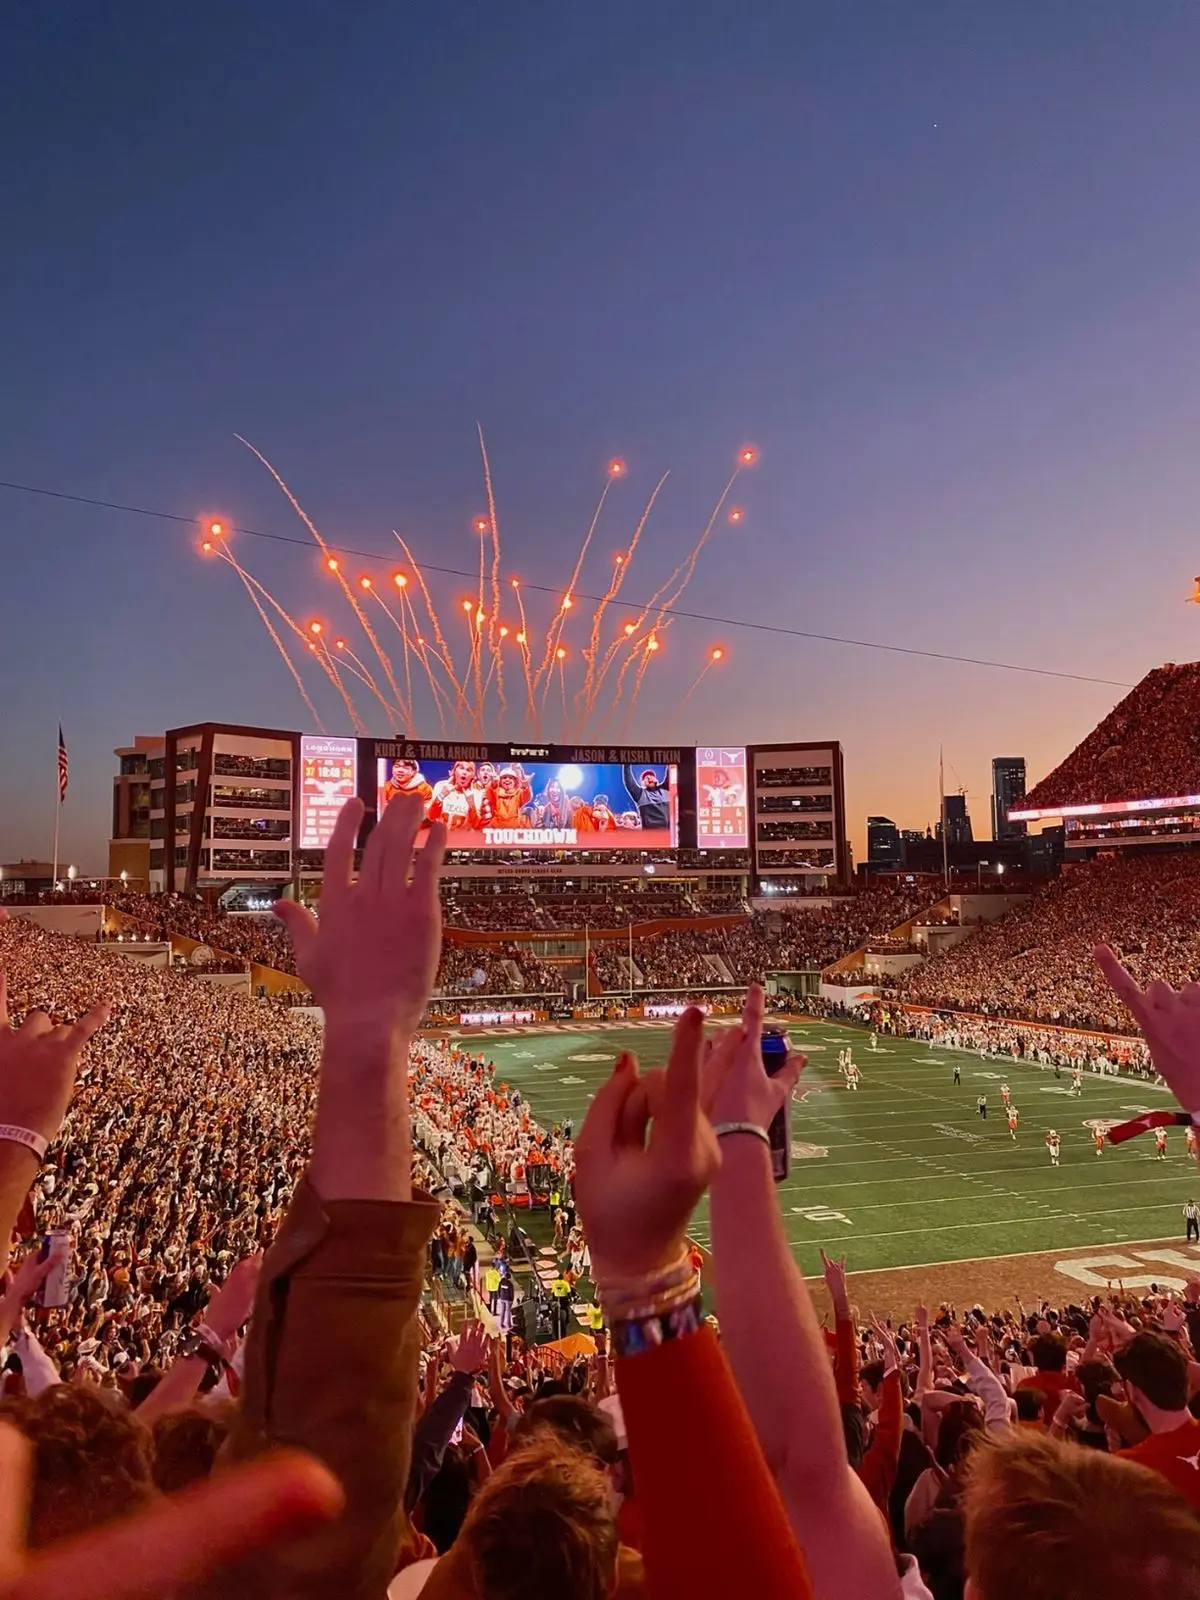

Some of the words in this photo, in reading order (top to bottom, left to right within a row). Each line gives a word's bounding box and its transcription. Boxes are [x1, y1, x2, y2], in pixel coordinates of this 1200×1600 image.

[306, 745, 353, 753] LONGHORN
[374, 742, 403, 758] KURT
[404, 744, 416, 758] &
[419, 744, 445, 759] TARA
[447, 745, 489, 760] ARNOLD
[571, 749, 606, 763] JASON
[608, 750, 619, 763] &
[620, 750, 651, 763] KISHA
[653, 750, 681, 763] ITKIN
[482, 828, 579, 845] TOUCHDOWN
